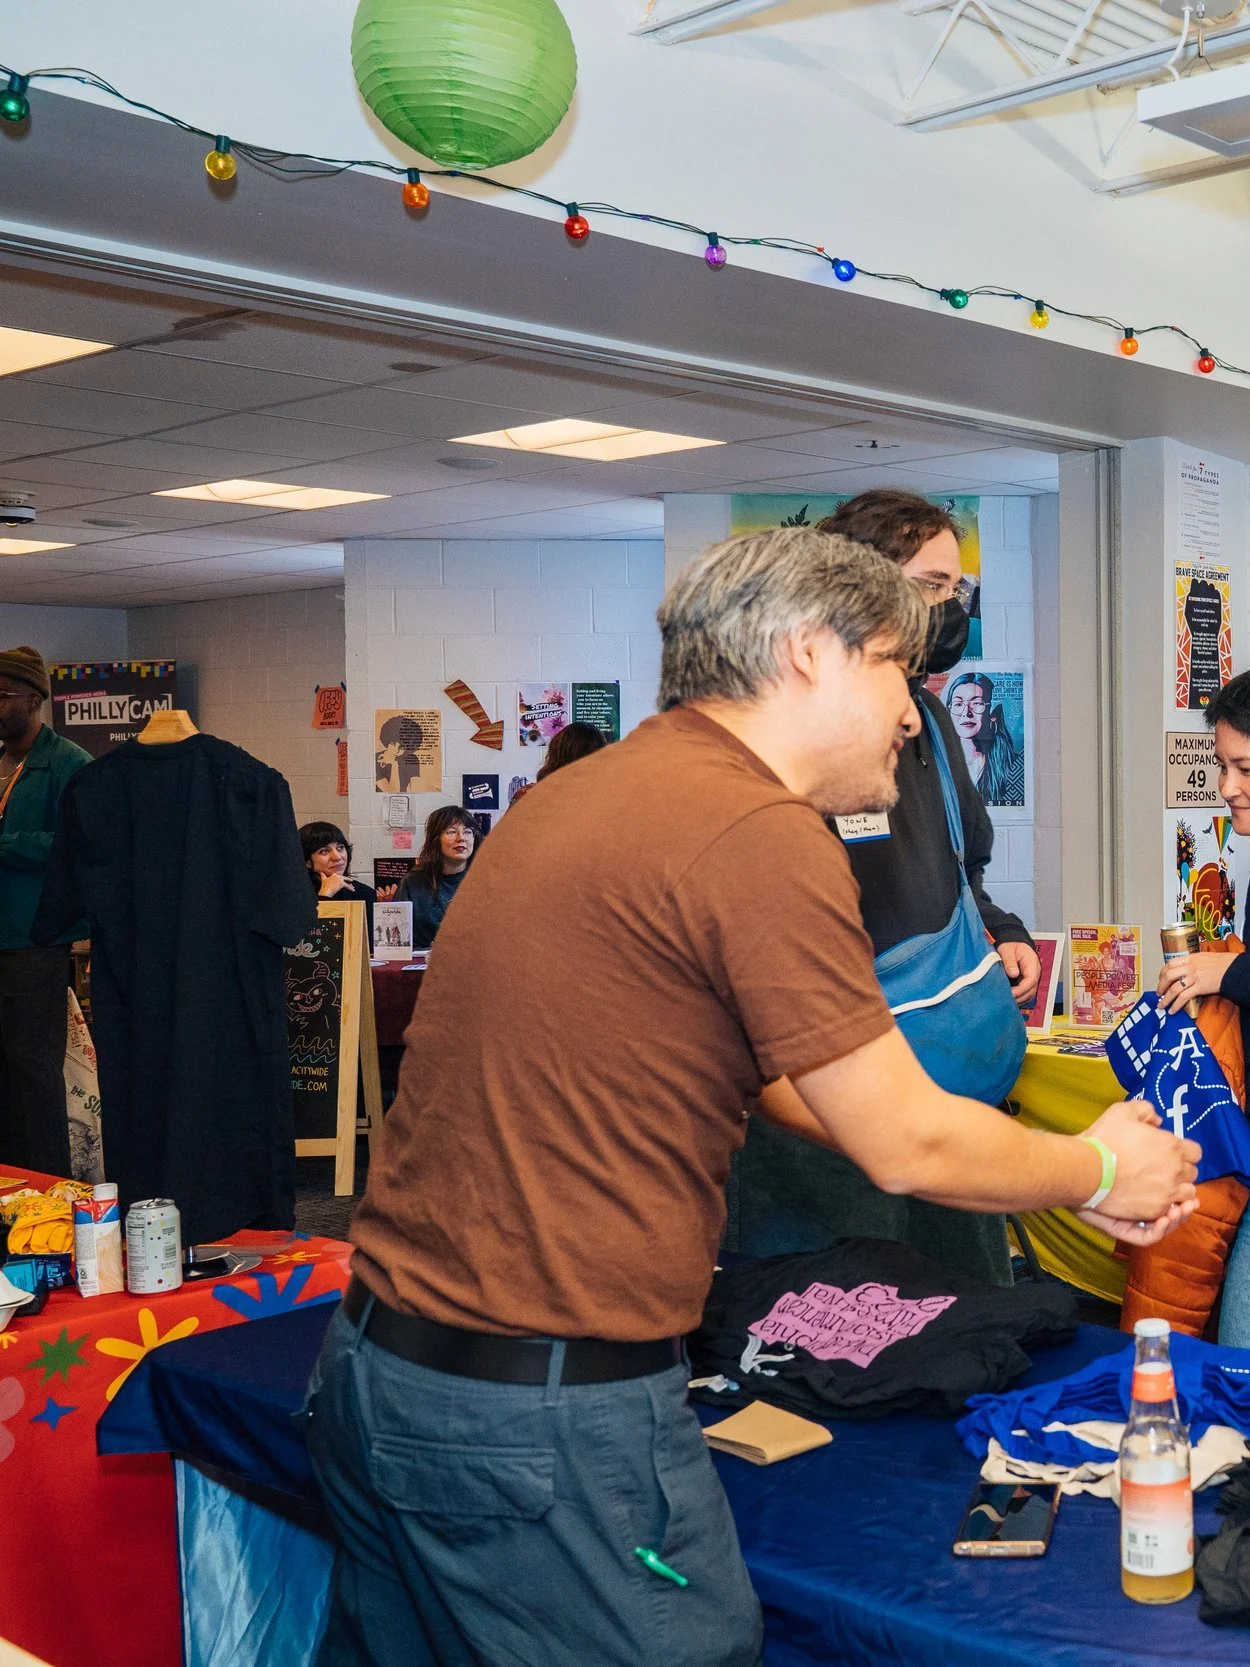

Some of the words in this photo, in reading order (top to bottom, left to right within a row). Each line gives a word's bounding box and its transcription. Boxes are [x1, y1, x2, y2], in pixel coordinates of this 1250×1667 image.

[1188, 473, 1220, 485] PROPAGANDA
[1204, 470, 1220, 479] TYPES
[1176, 567, 1191, 577] BRAVE
[1191, 569, 1205, 579] SPACE
[1206, 570, 1229, 581] AGREEMENT
[68, 699, 168, 721] PHILLYCAM
[531, 702, 559, 710] SETTING
[1175, 738, 1216, 750] MAXIMUM
[1169, 753, 1217, 766] OCCUPANC
[1187, 769, 1207, 788] 49
[1176, 790, 1217, 801] PERSONS
[1195, 867, 1222, 940] Free
[1076, 971, 1104, 980] PEOPLE
[1106, 972, 1136, 981] POWER
[1088, 981, 1117, 990] MEDIA
[1118, 982, 1135, 990] FEST
